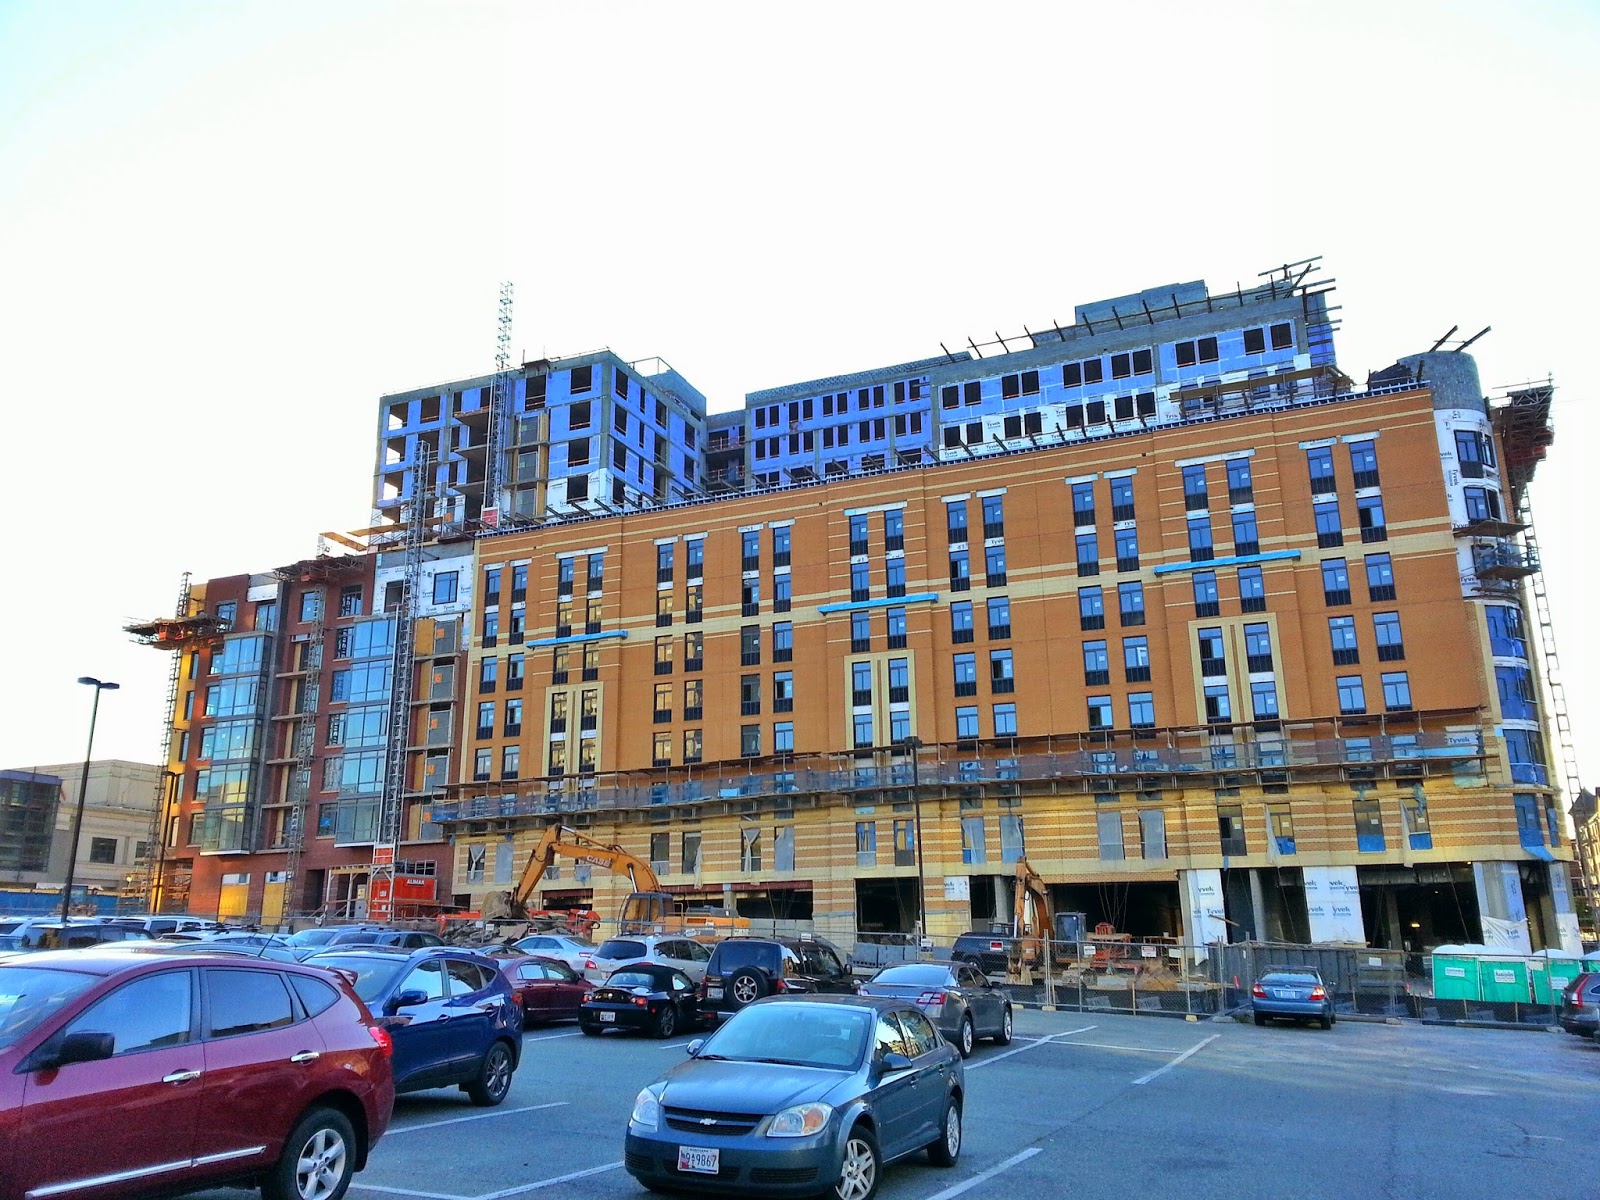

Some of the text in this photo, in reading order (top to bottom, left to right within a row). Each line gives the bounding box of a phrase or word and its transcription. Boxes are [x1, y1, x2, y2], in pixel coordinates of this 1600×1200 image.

[586, 855, 612, 868] CASE
[1198, 885, 1214, 893] yvek
[1308, 905, 1324, 914] yvek
[1332, 905, 1351, 914] yvek
